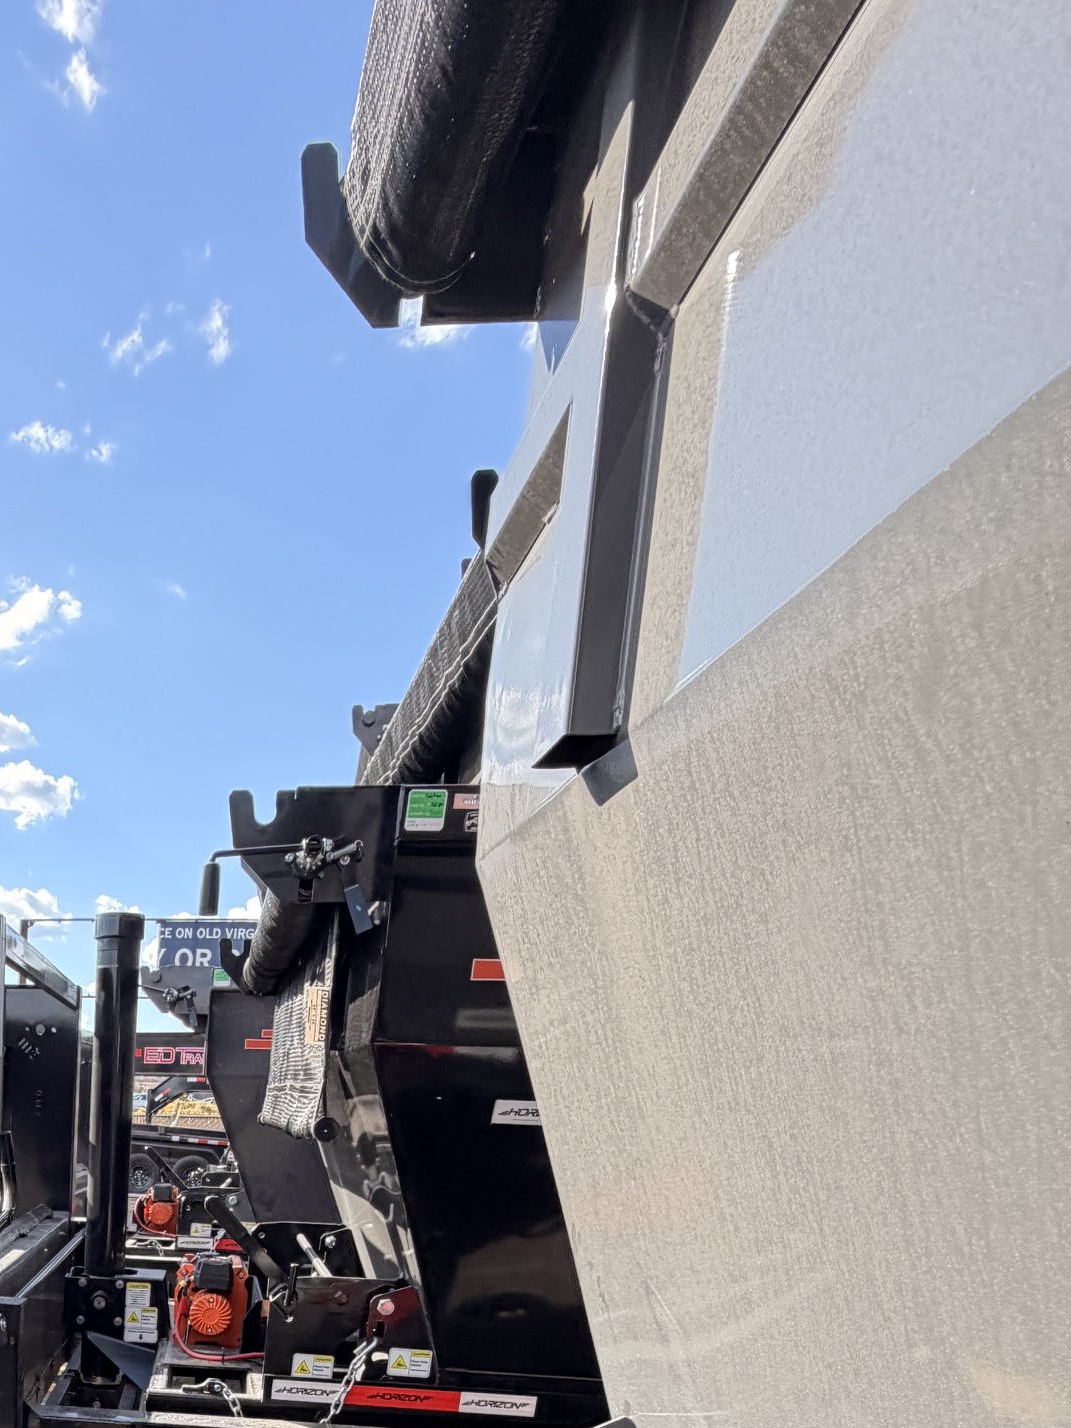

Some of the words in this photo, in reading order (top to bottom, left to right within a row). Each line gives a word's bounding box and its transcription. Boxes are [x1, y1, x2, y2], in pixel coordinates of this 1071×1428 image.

[175, 927, 193, 939] ON
[196, 927, 221, 939] OLD
[319, 989, 329, 1041] DIAMOND
[280, 1385, 333, 1397] HORIZON
[468, 1398, 525, 1411] HORIZON
